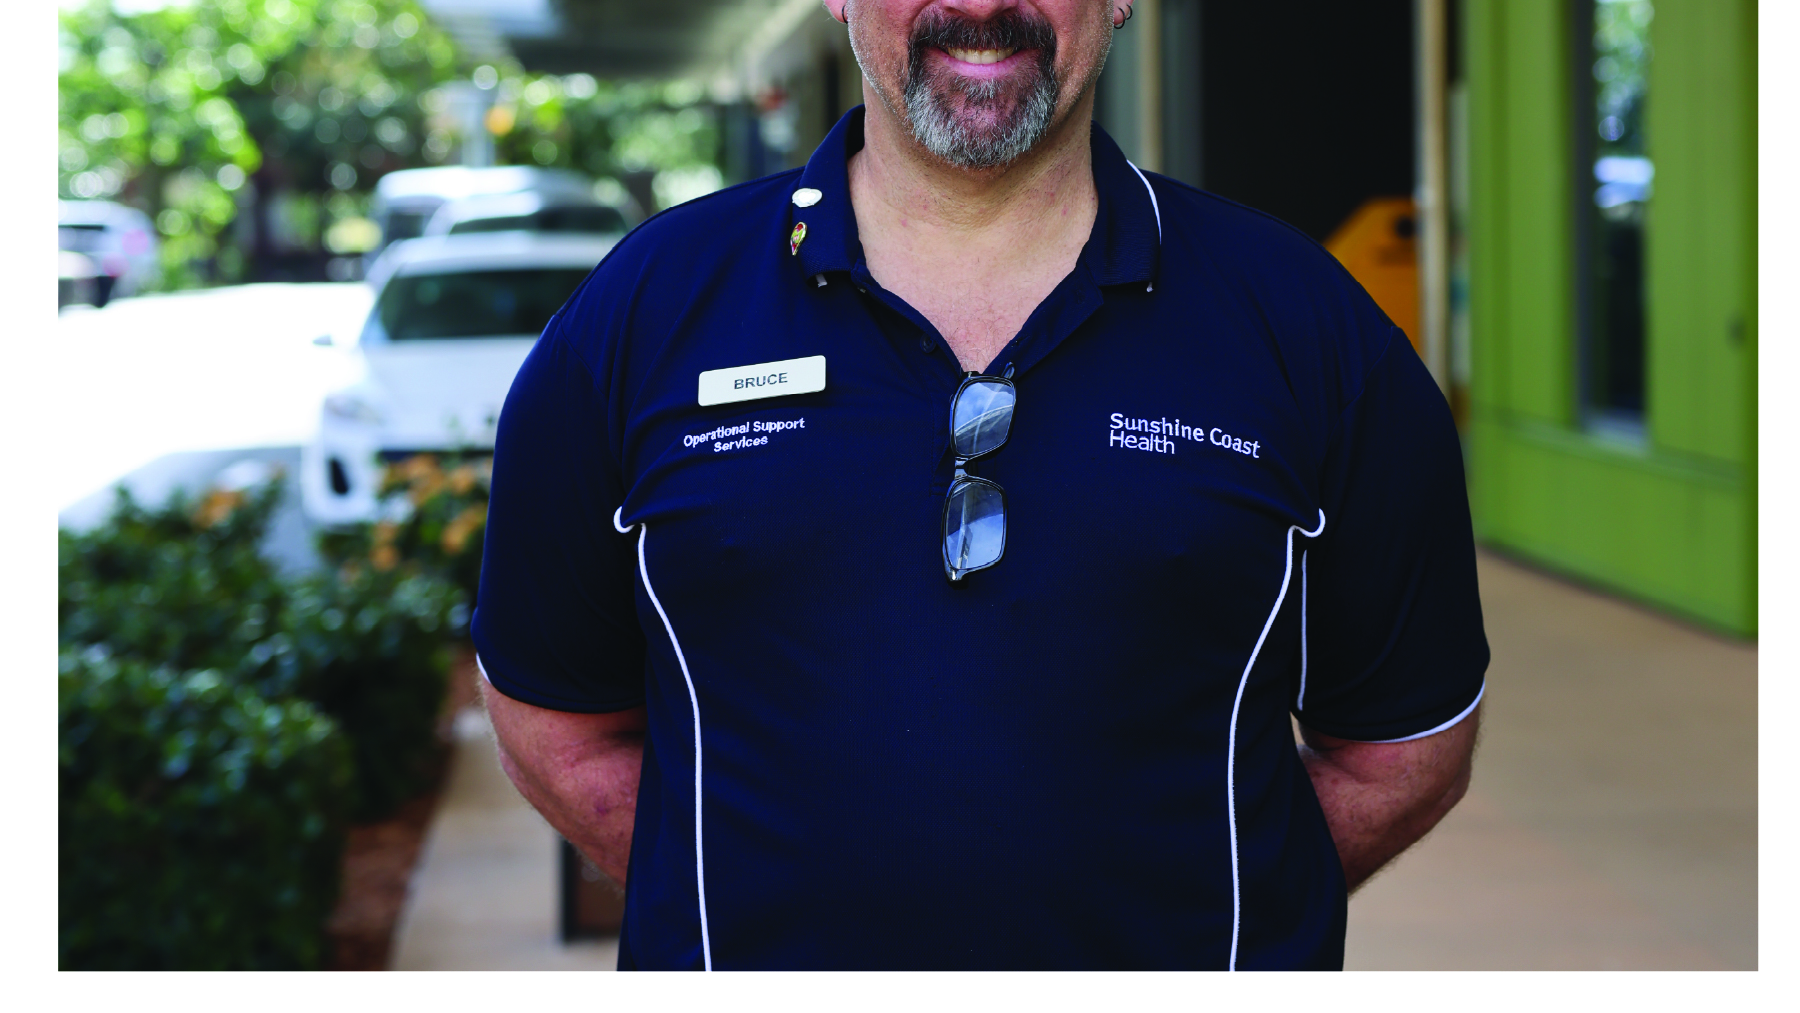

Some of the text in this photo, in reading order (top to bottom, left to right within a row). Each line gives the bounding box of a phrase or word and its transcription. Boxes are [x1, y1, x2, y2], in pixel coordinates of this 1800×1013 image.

[733, 372, 788, 390] BRUCE
[683, 417, 806, 448] Operational Support
[713, 435, 769, 453] Services
[1109, 412, 1261, 459] Sunshine Coast
[1109, 429, 1175, 455] Health
